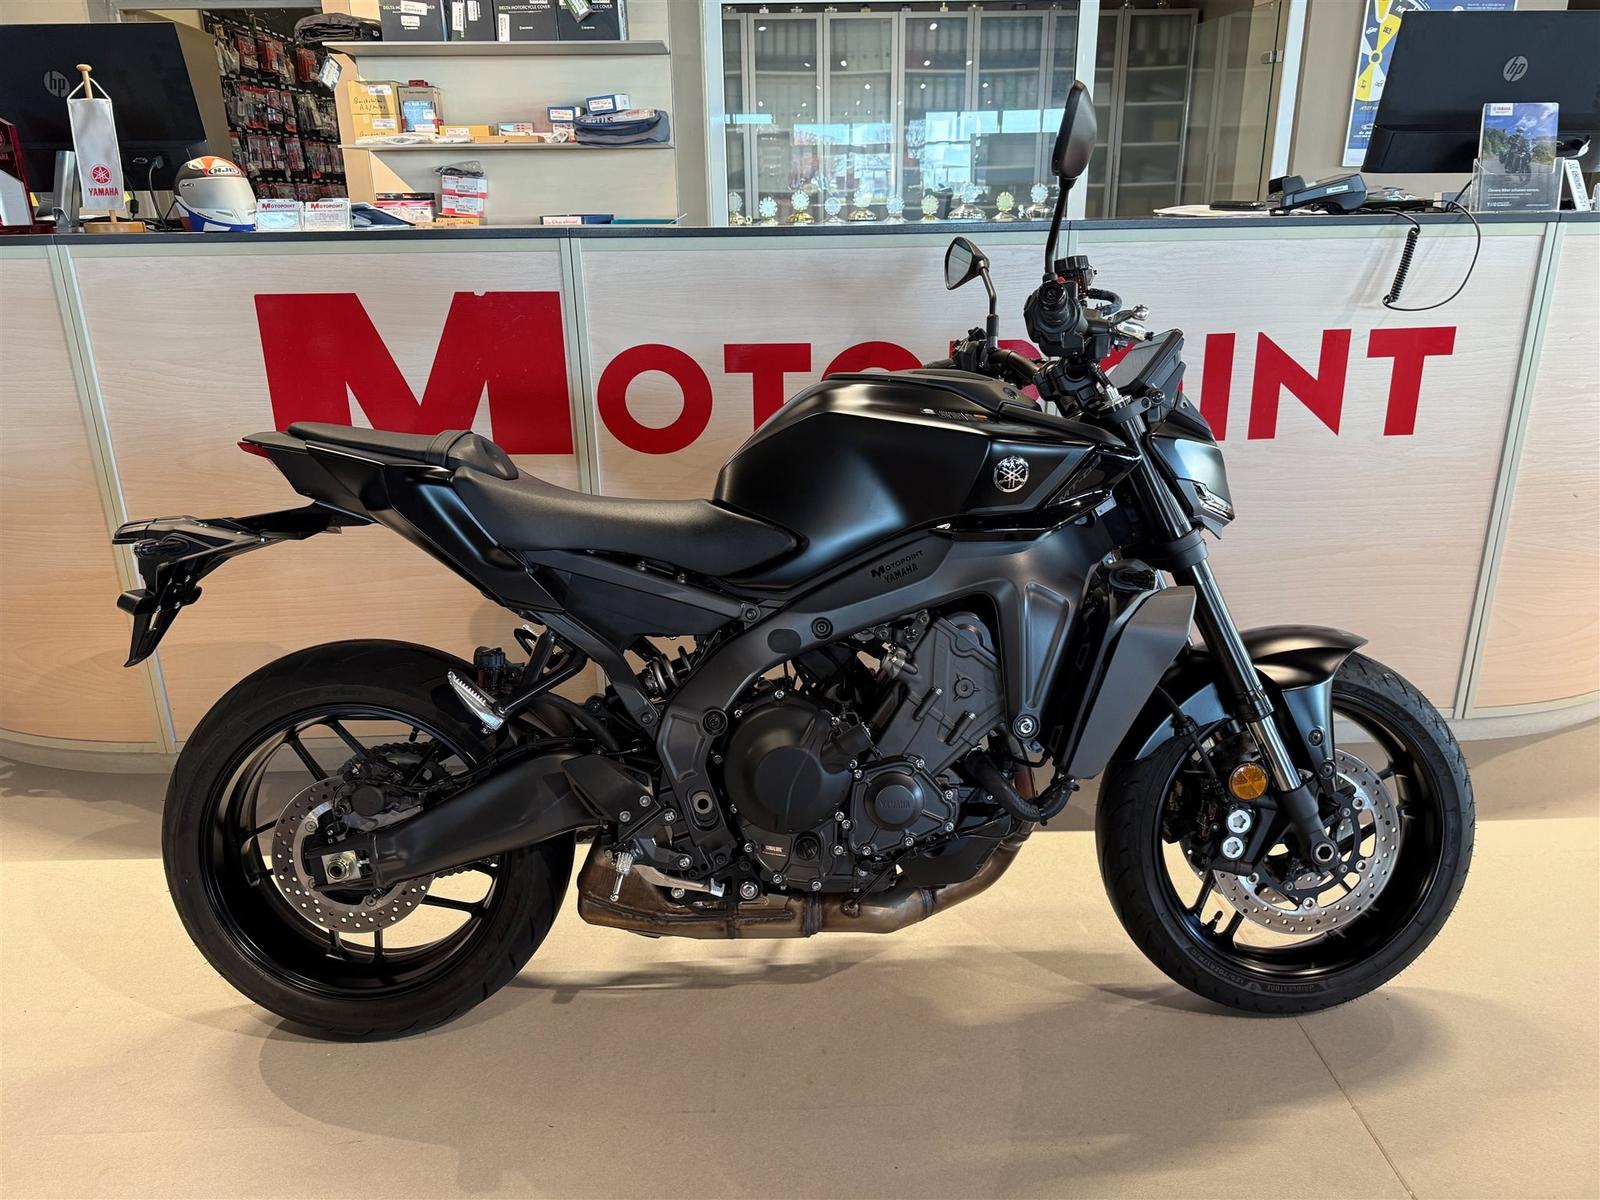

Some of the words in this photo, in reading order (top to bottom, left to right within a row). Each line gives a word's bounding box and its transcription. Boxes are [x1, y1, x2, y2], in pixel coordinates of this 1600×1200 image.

[1505, 56, 1527, 82] hp
[48, 71, 66, 98] hp
[88, 187, 120, 197] YAMAHA
[870, 550, 924, 578] MOTOPOINT
[884, 563, 919, 583] YAMAHA
[880, 799, 911, 809] YAMAHA
